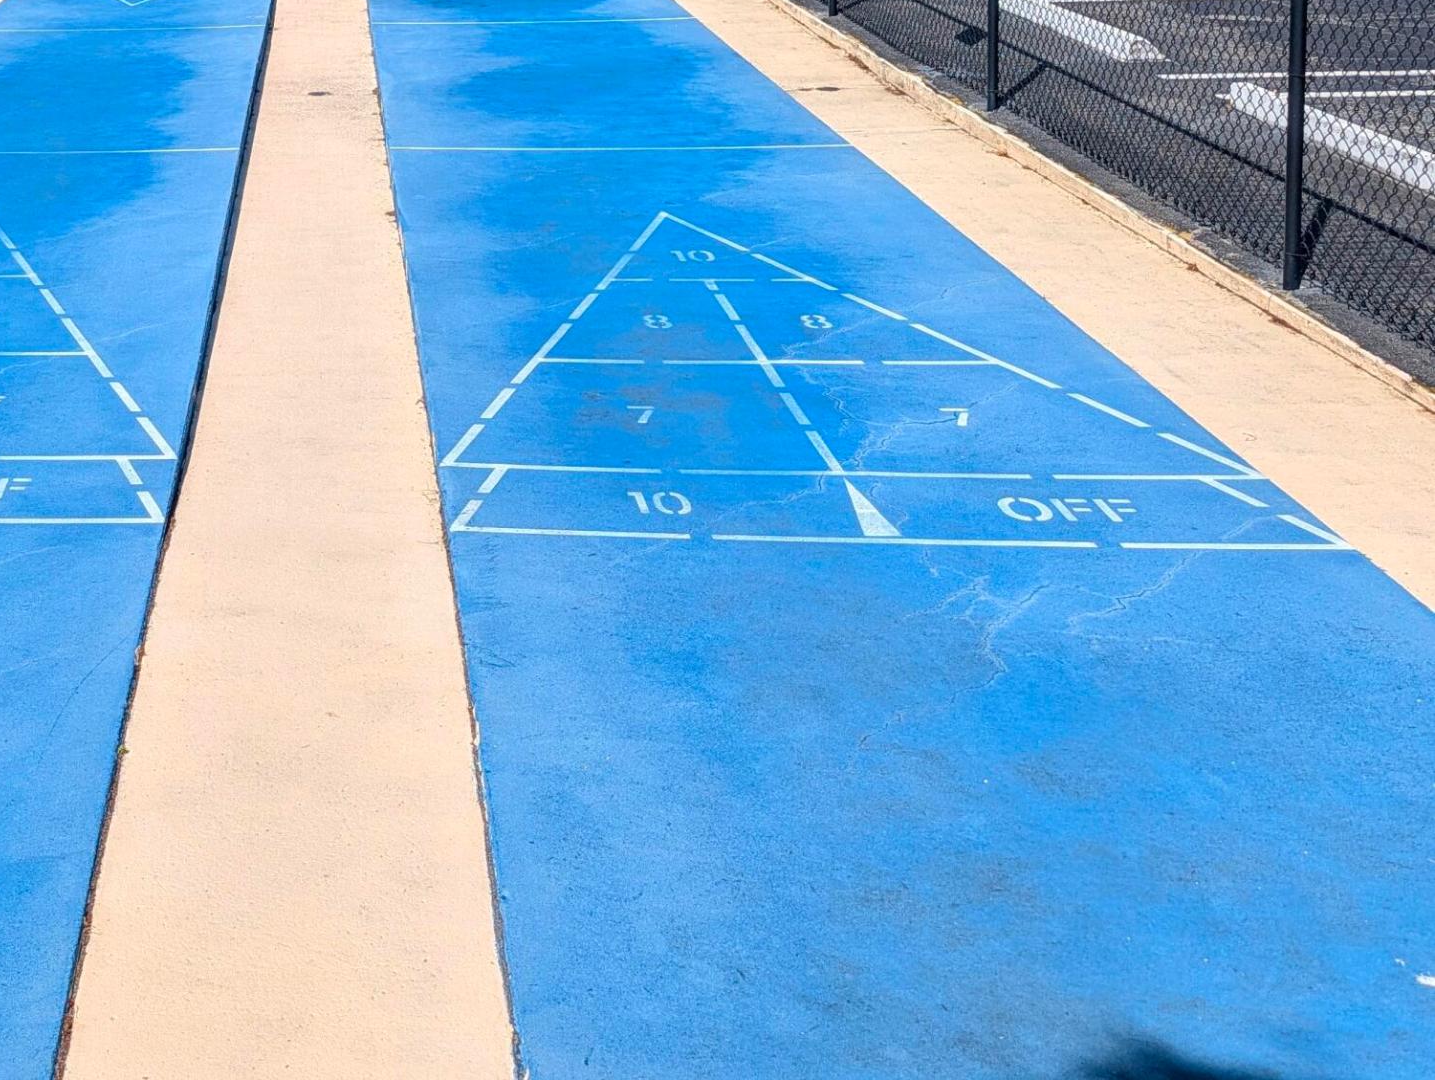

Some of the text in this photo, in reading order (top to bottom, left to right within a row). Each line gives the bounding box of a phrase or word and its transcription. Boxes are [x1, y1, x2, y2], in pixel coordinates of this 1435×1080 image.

[672, 249, 716, 262] 10
[644, 315, 672, 328] 8
[801, 315, 832, 328] 8
[628, 406, 654, 423] 7
[940, 408, 968, 426] 7
[628, 492, 1136, 522] 10 OFF
